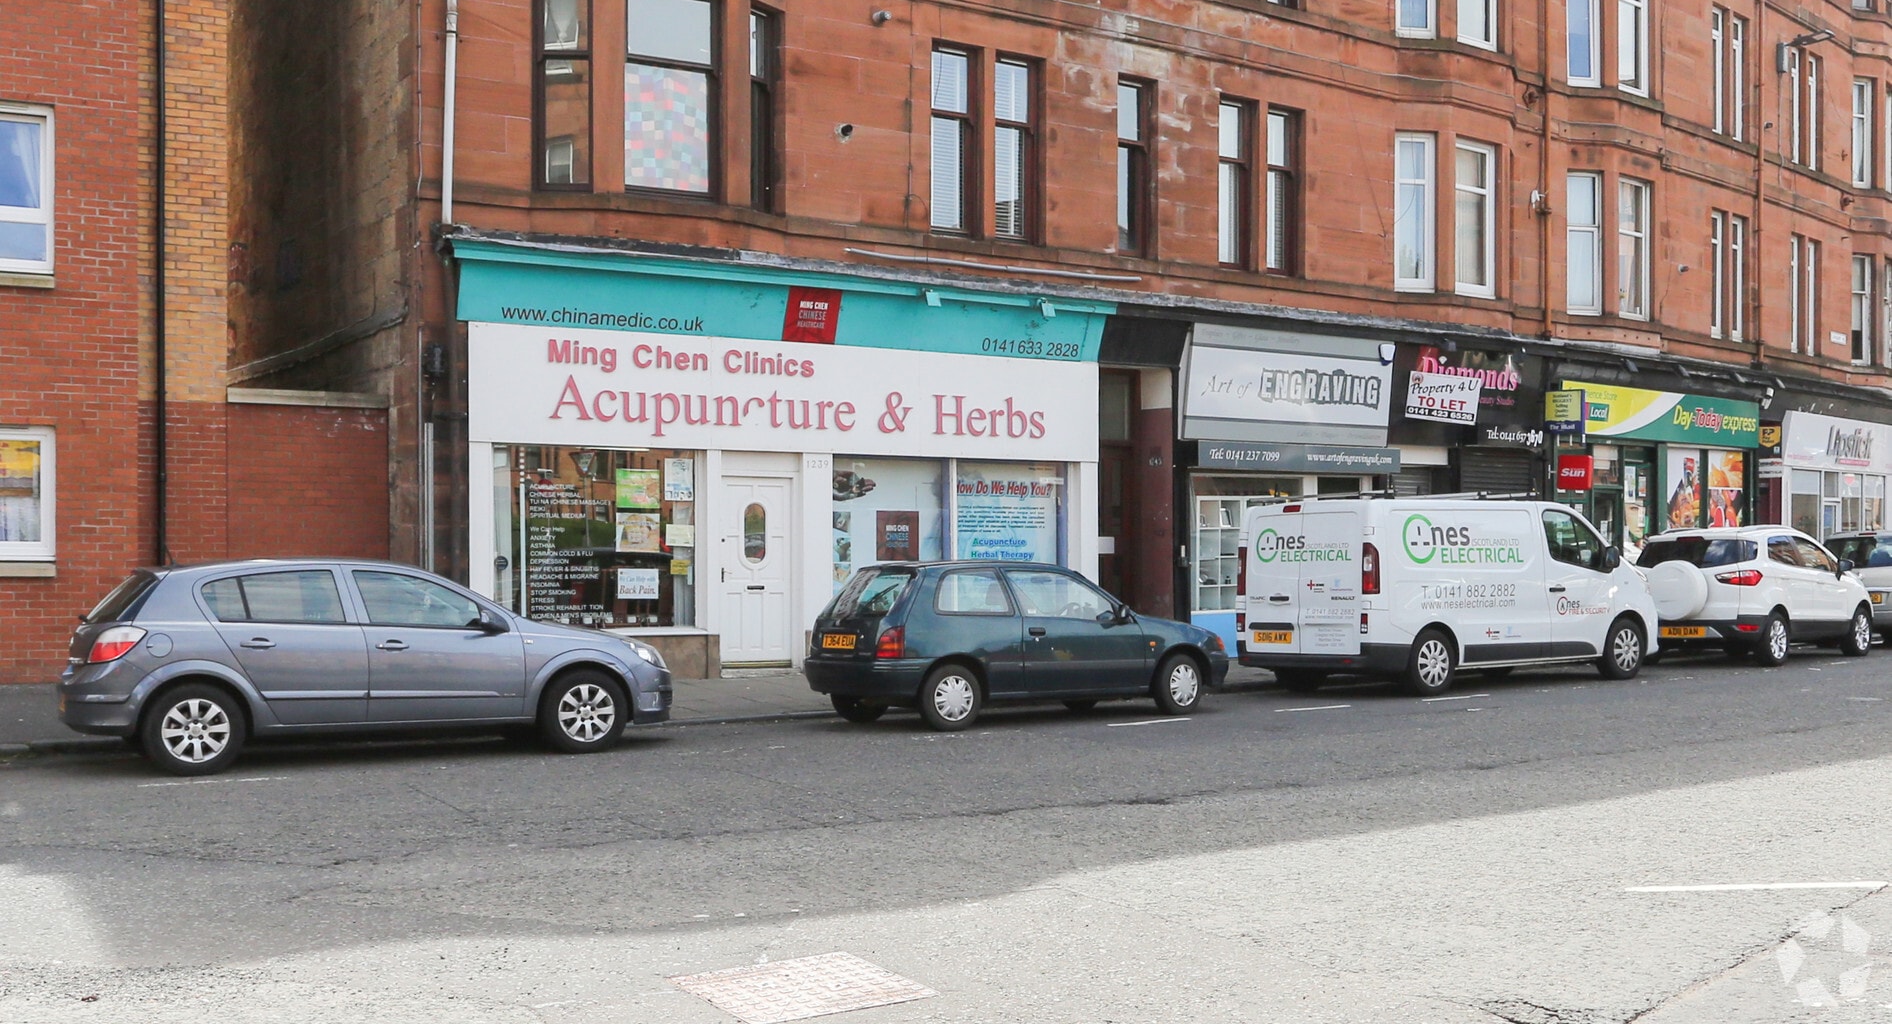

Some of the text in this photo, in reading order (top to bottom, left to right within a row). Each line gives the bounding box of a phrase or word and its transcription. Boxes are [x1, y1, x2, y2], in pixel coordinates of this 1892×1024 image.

[800, 301, 828, 310] MING CHEN
[501, 306, 704, 332] www.chinamedic.co.uk
[799, 310, 827, 320] CHINESE
[1046, 342, 1079, 357] 2828
[548, 339, 815, 377] Ming Chen Clinics
[1201, 370, 1381, 408] Art of ENGRAVING
[1411, 379, 1479, 396] Property 4 U
[1418, 396, 1466, 411] TO LET
[1479, 396, 1494, 406] eauty
[878, 391, 913, 434] &
[932, 394, 1046, 439] Herbs
[1408, 407, 1428, 415] 0141
[1431, 409, 1448, 417] 423
[1590, 407, 1607, 419] Local
[1723, 414, 1757, 434] express
[1500, 432, 1515, 442] 0141
[1226, 450, 1244, 461] 0141
[1246, 451, 1260, 461] 237
[1262, 451, 1280, 462] 7099
[806, 460, 829, 468] 1239
[1560, 468, 1585, 477] Sun
[976, 481, 988, 494] Do
[991, 481, 1004, 495] We
[1007, 481, 1027, 498] Help
[1030, 481, 1052, 496] You?
[973, 538, 1026, 546] Acupuncture
[1508, 538, 1519, 546] LTD
[1000, 551, 1034, 560] Therapy
[1280, 550, 1352, 562] ELECTRICAL
[1441, 548, 1524, 563] ELECTRICAL
[619, 585, 637, 594] Back
[1422, 584, 1516, 599] T. 0141 882 2882
[1421, 599, 1516, 610] www.neselectrical.com
